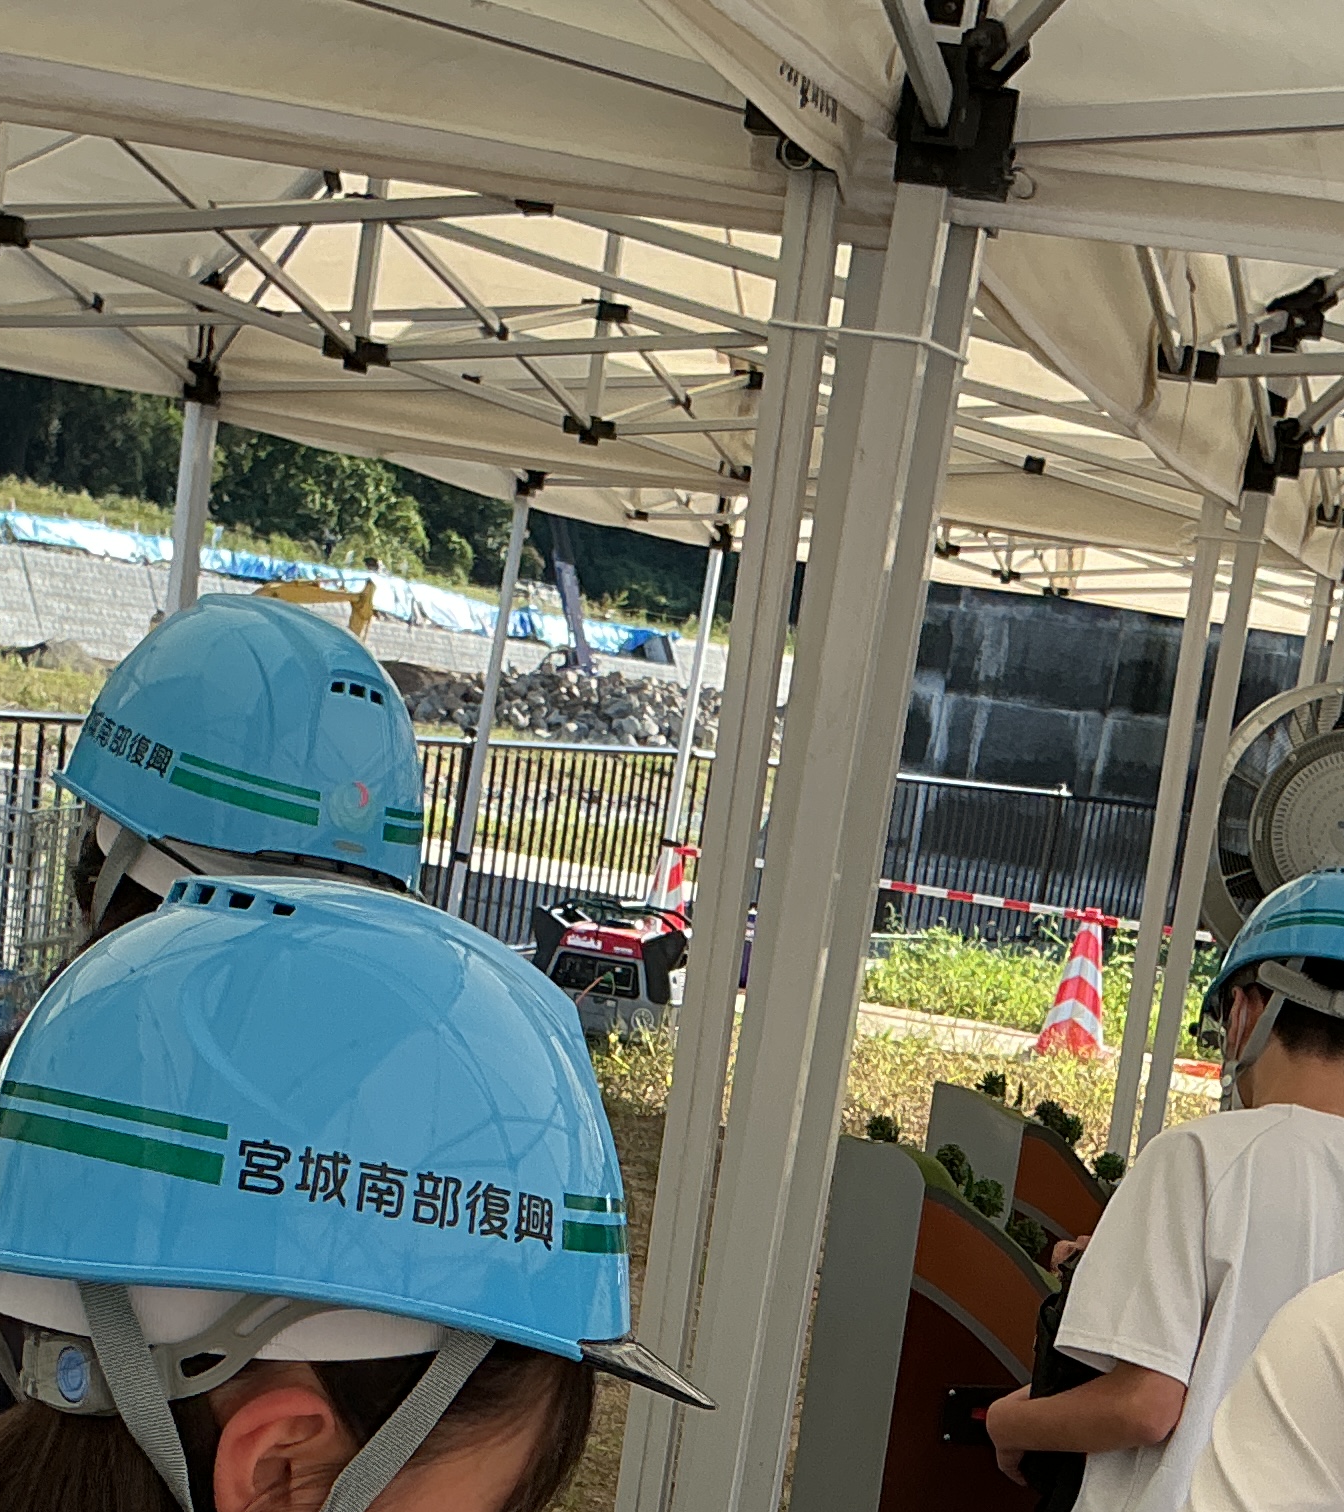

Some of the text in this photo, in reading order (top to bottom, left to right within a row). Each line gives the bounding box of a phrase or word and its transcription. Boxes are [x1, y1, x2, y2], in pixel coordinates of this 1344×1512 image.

[237, 1139, 554, 1251] 宮城南部復興
